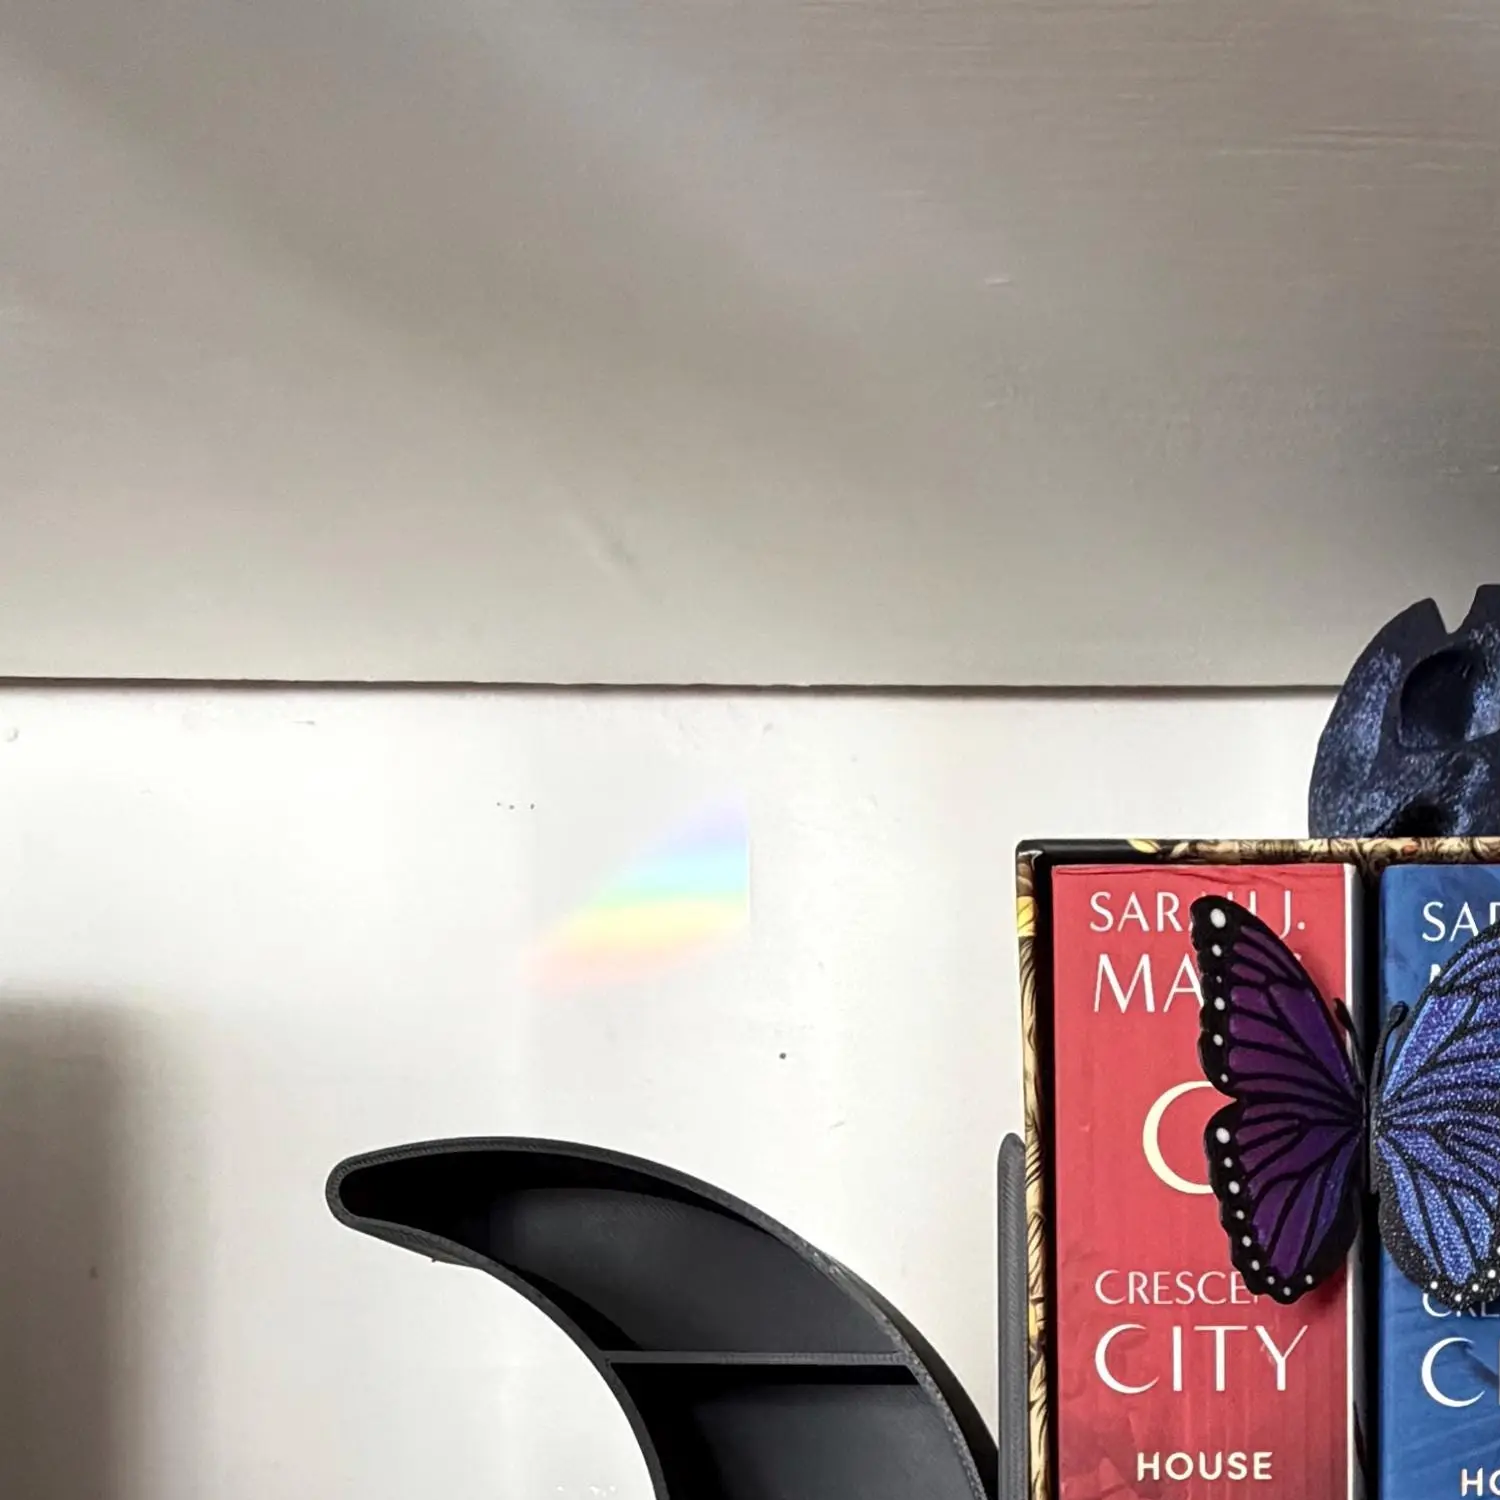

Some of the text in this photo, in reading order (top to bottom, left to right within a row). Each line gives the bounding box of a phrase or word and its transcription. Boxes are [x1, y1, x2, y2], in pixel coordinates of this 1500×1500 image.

[1089, 890, 1306, 939] SAR J.
[1094, 1269, 1259, 1305] CRESCE
[1095, 1323, 1309, 1394] CITY
[1136, 1451, 1273, 1481] HOUSE
